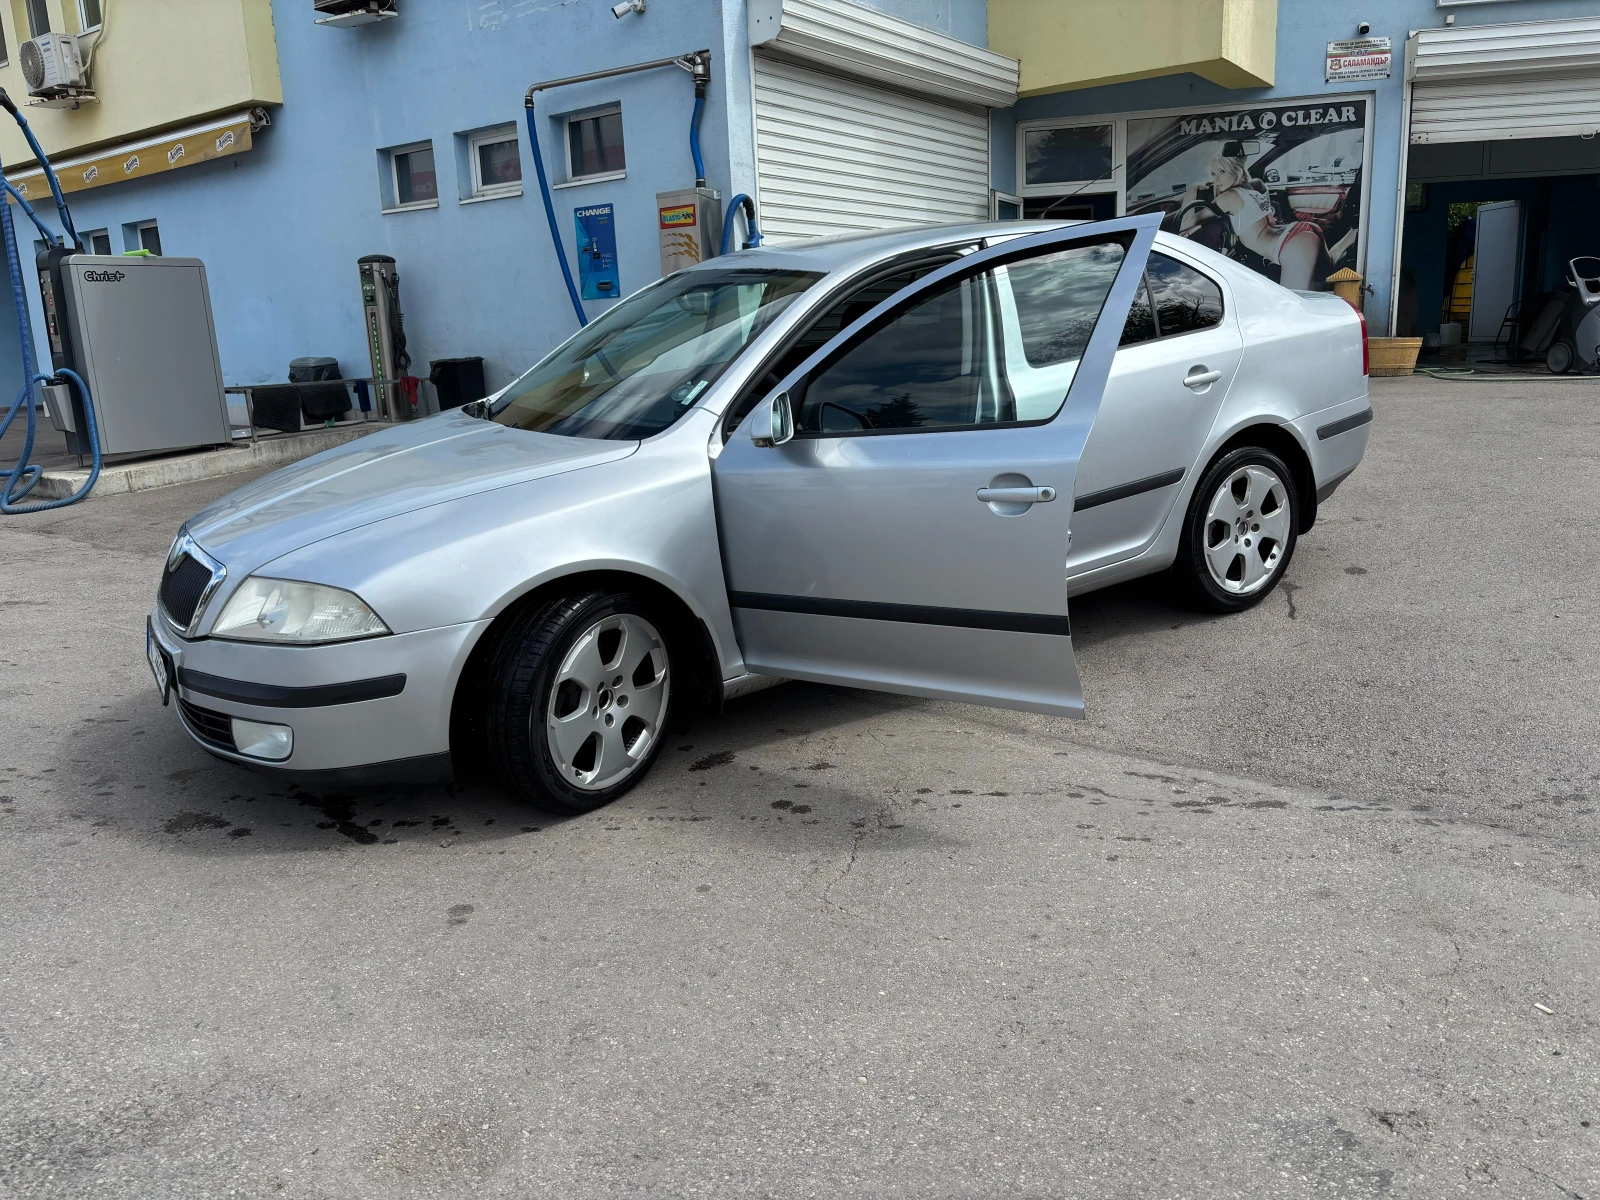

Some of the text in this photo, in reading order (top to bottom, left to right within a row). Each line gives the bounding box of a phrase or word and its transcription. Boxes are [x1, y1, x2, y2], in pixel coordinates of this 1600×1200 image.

[1343, 57, 1389, 67] САЛАМАНДЪР
[1180, 106, 1357, 136] MANIA CLEAR
[576, 207, 611, 218] CHANGE
[84, 270, 125, 282] Christ
